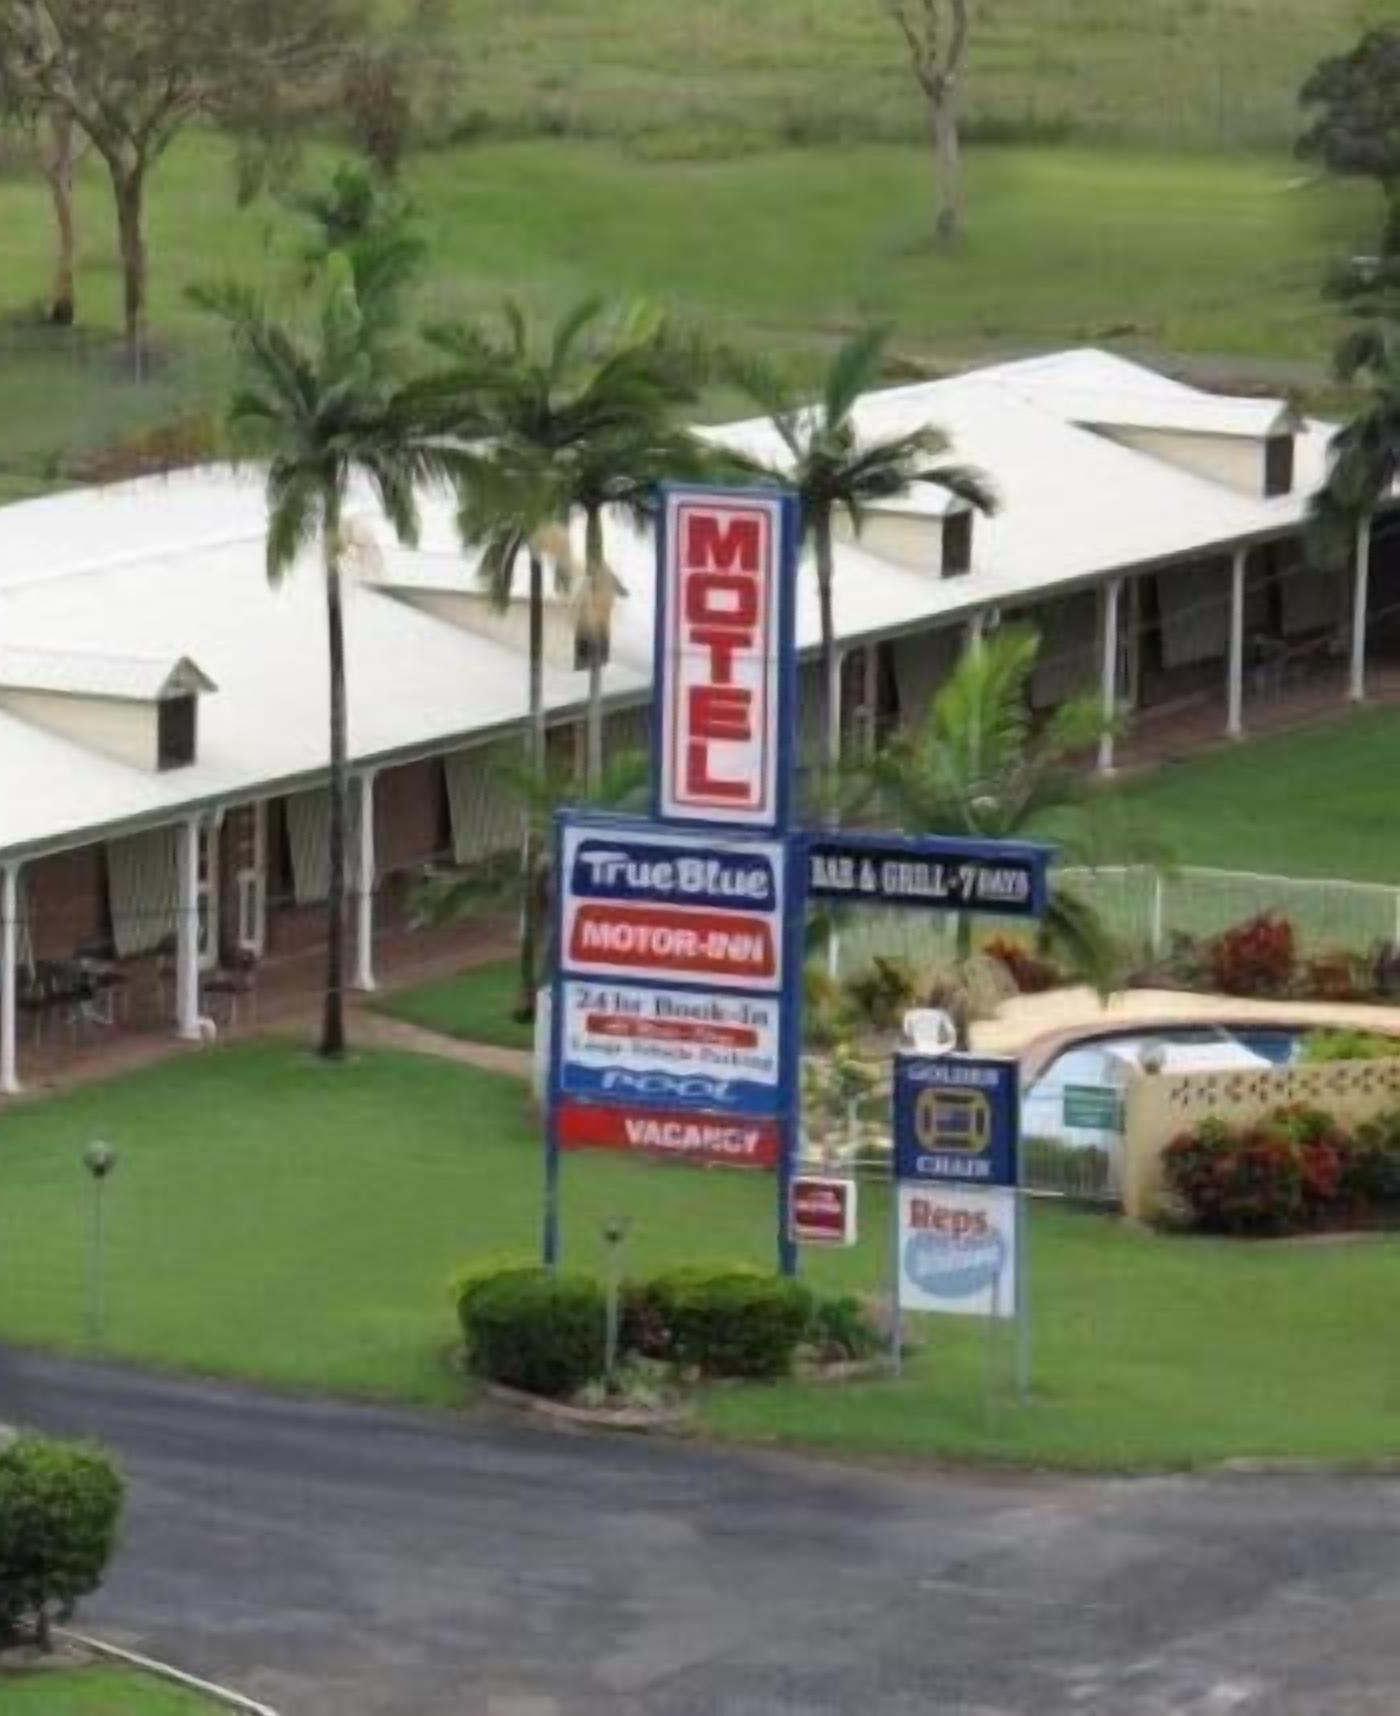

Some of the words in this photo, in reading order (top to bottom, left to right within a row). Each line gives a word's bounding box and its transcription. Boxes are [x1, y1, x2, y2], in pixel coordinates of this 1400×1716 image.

[686, 513, 760, 799] MOTEL
[881, 860, 948, 897] GRILL
[576, 987, 607, 1010] 24
[624, 1118, 760, 1154] VACANCY
